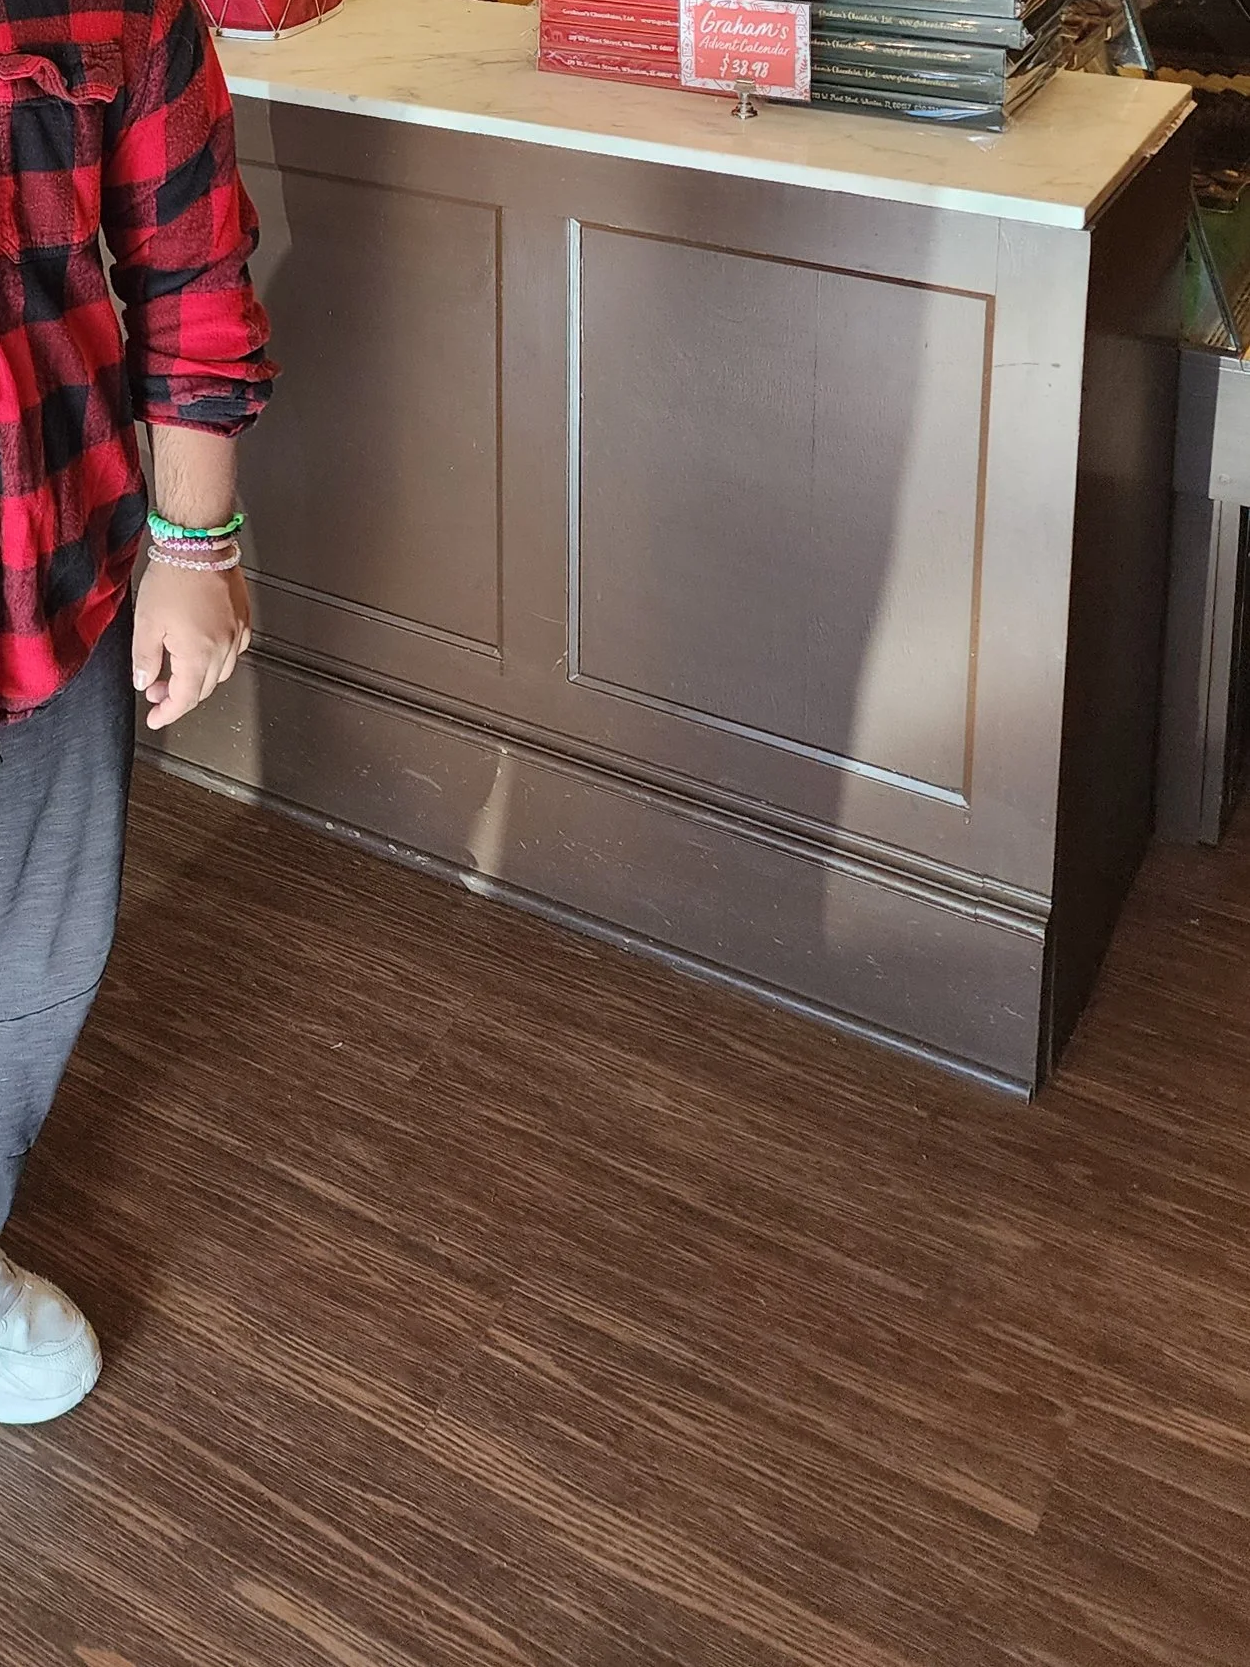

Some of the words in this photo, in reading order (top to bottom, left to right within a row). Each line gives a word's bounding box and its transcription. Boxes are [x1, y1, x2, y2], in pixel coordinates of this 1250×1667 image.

[701, 9, 790, 39] Graham's
[699, 35, 738, 54] Advent
[738, 39, 791, 57] Calendar
[719, 53, 770, 78] $38.98
